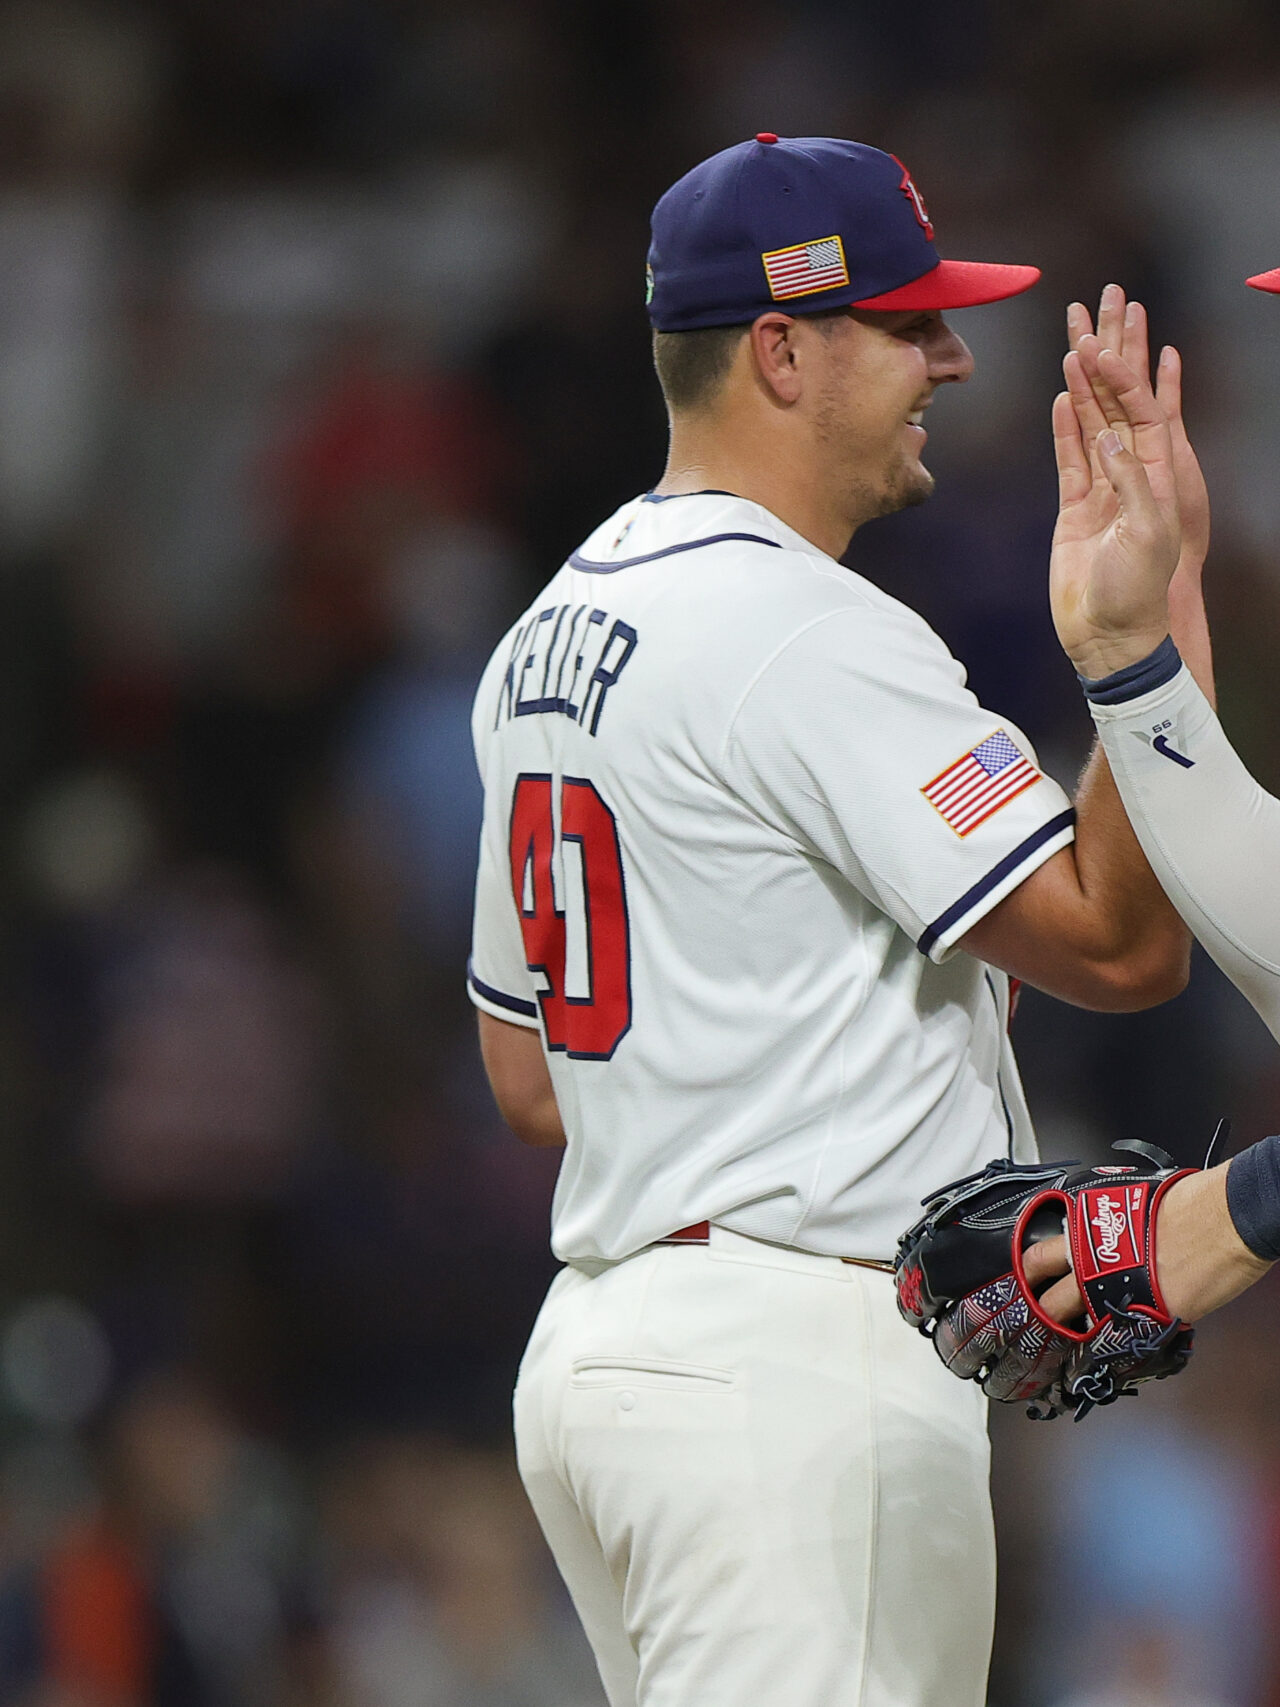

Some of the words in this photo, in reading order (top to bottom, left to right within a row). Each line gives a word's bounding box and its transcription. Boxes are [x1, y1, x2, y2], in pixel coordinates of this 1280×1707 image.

[493, 604, 638, 738] KELLER
[509, 772, 632, 1062] 40
[1091, 1193, 1121, 1264] Rawlings
